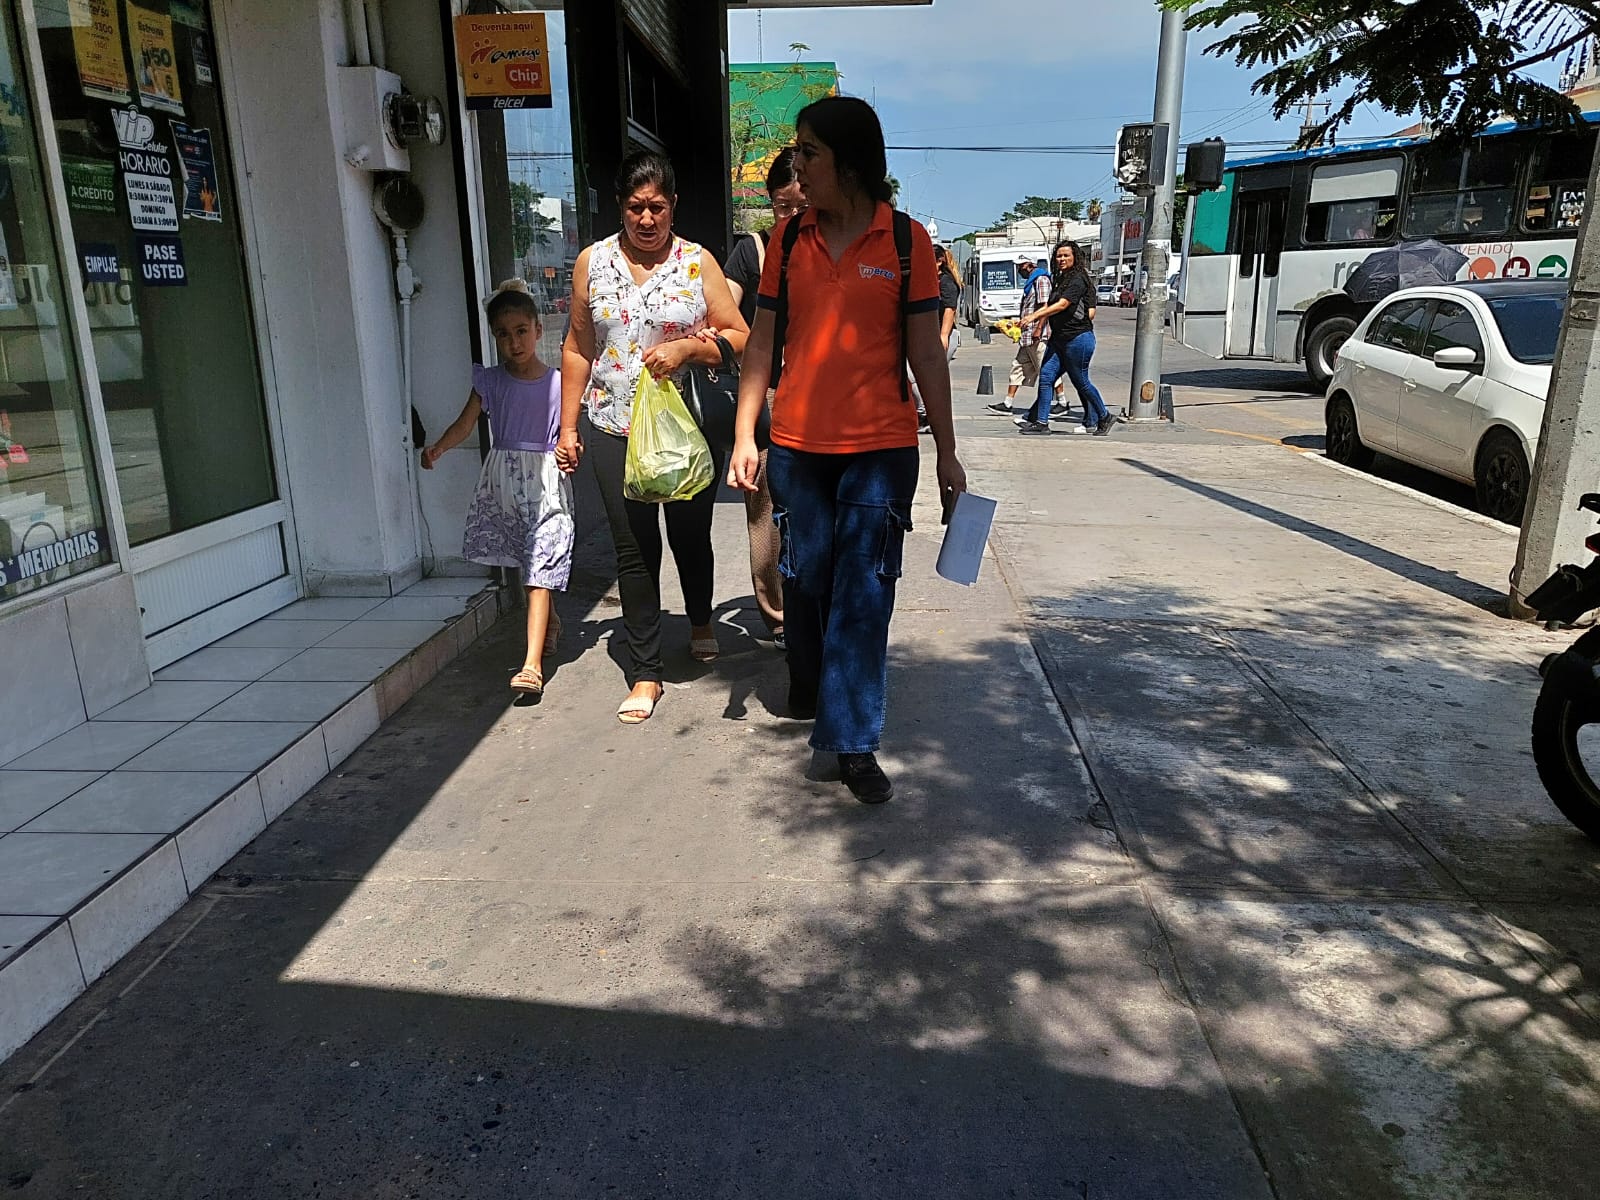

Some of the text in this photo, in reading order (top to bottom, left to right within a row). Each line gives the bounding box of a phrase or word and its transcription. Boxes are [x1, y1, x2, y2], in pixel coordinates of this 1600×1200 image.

[471, 23, 483, 32] De
[485, 23, 511, 32] venta
[490, 47, 541, 63] amigo
[509, 68, 539, 84] Chip
[493, 96, 526, 109] telcel
[143, 141, 168, 153] Celular
[119, 151, 170, 175] HORARIO
[71, 184, 78, 198] A
[127, 179, 146, 190] LUNES
[140, 204, 166, 215] DOMINGO
[144, 244, 178, 260] PASE
[85, 256, 118, 273] EMPUJE
[142, 263, 185, 279] USTED
[17, 530, 100, 579] MEMORIAS
